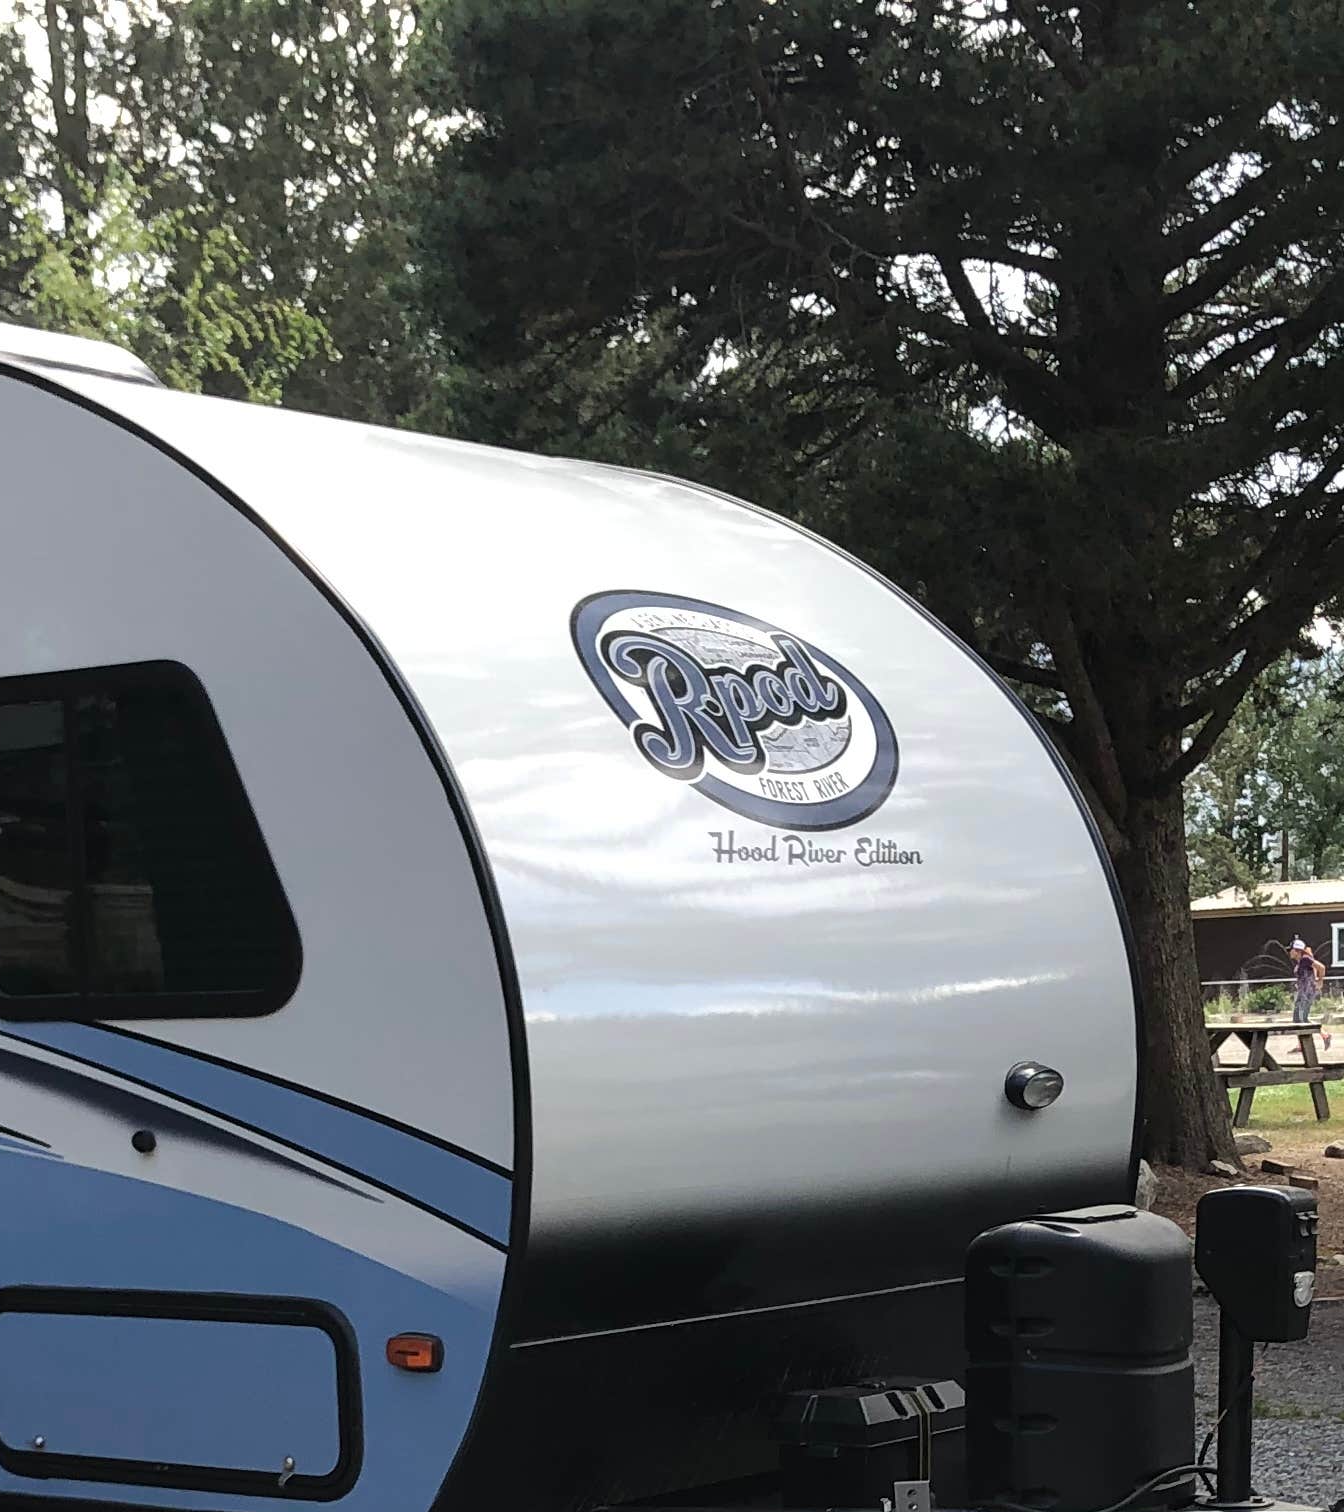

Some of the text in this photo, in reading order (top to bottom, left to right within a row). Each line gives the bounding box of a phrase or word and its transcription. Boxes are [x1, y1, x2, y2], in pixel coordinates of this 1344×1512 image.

[759, 771, 849, 801] FOREST RIVER
[707, 830, 923, 867] Hood River Edition
